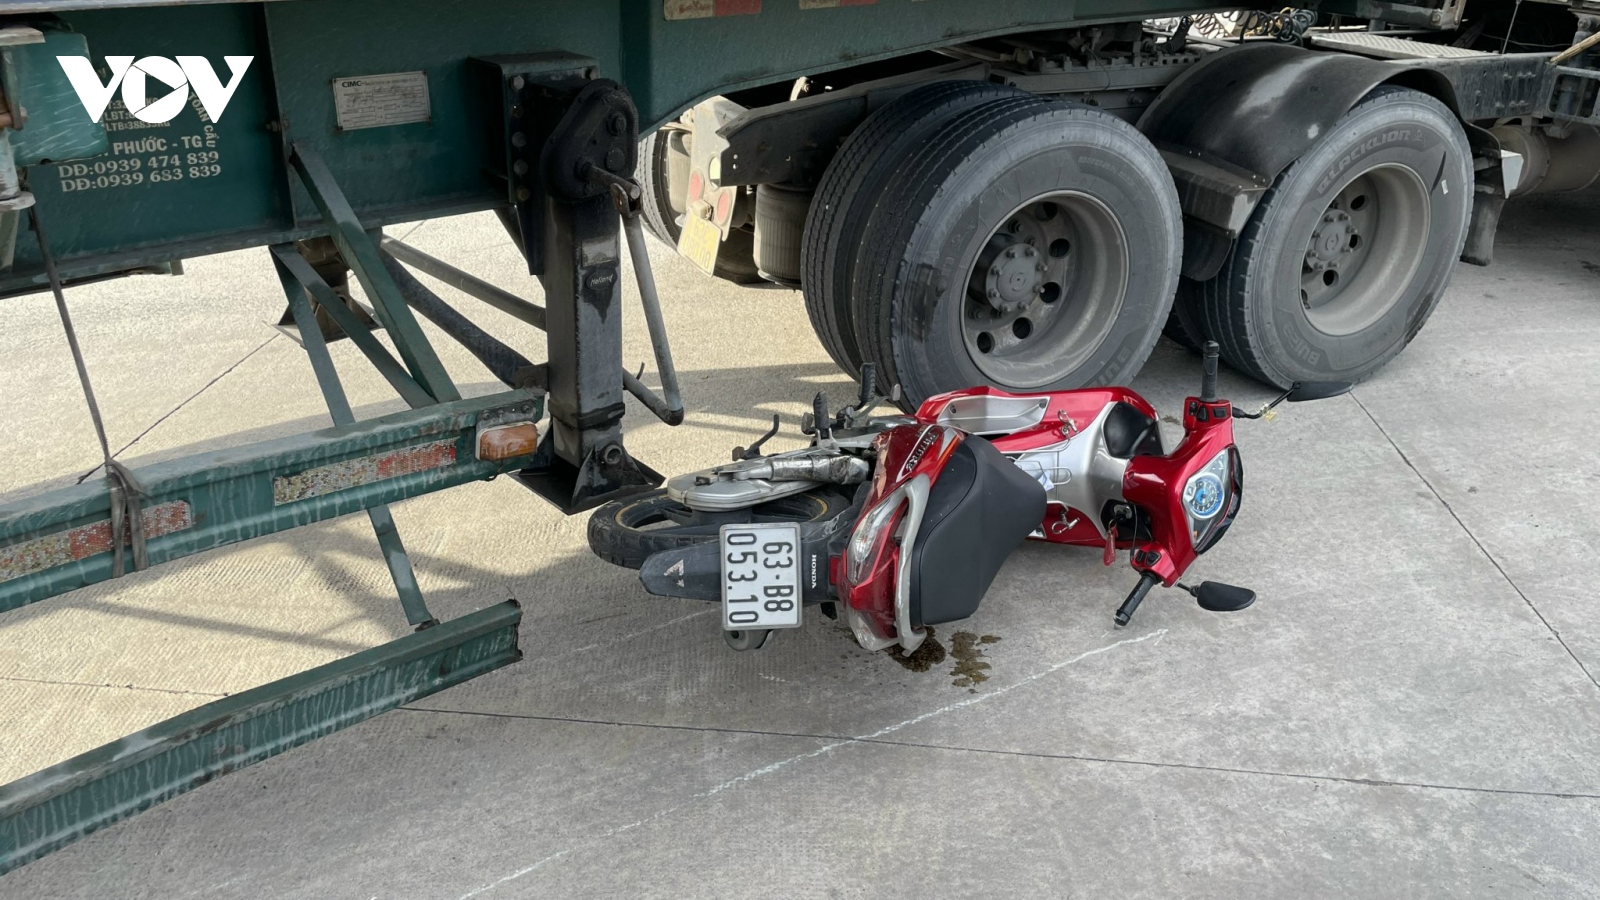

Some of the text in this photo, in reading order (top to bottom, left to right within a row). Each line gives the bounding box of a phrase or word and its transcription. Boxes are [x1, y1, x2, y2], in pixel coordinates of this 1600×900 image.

[113, 136, 168, 155] PHƯỚC
[181, 135, 202, 149] TG
[58, 150, 219, 178] DĐ:0939 474 839
[61, 164, 221, 192] DĐ:0939 683 839
[726, 532, 759, 624] 053.10
[810, 553, 818, 590] HONDA
